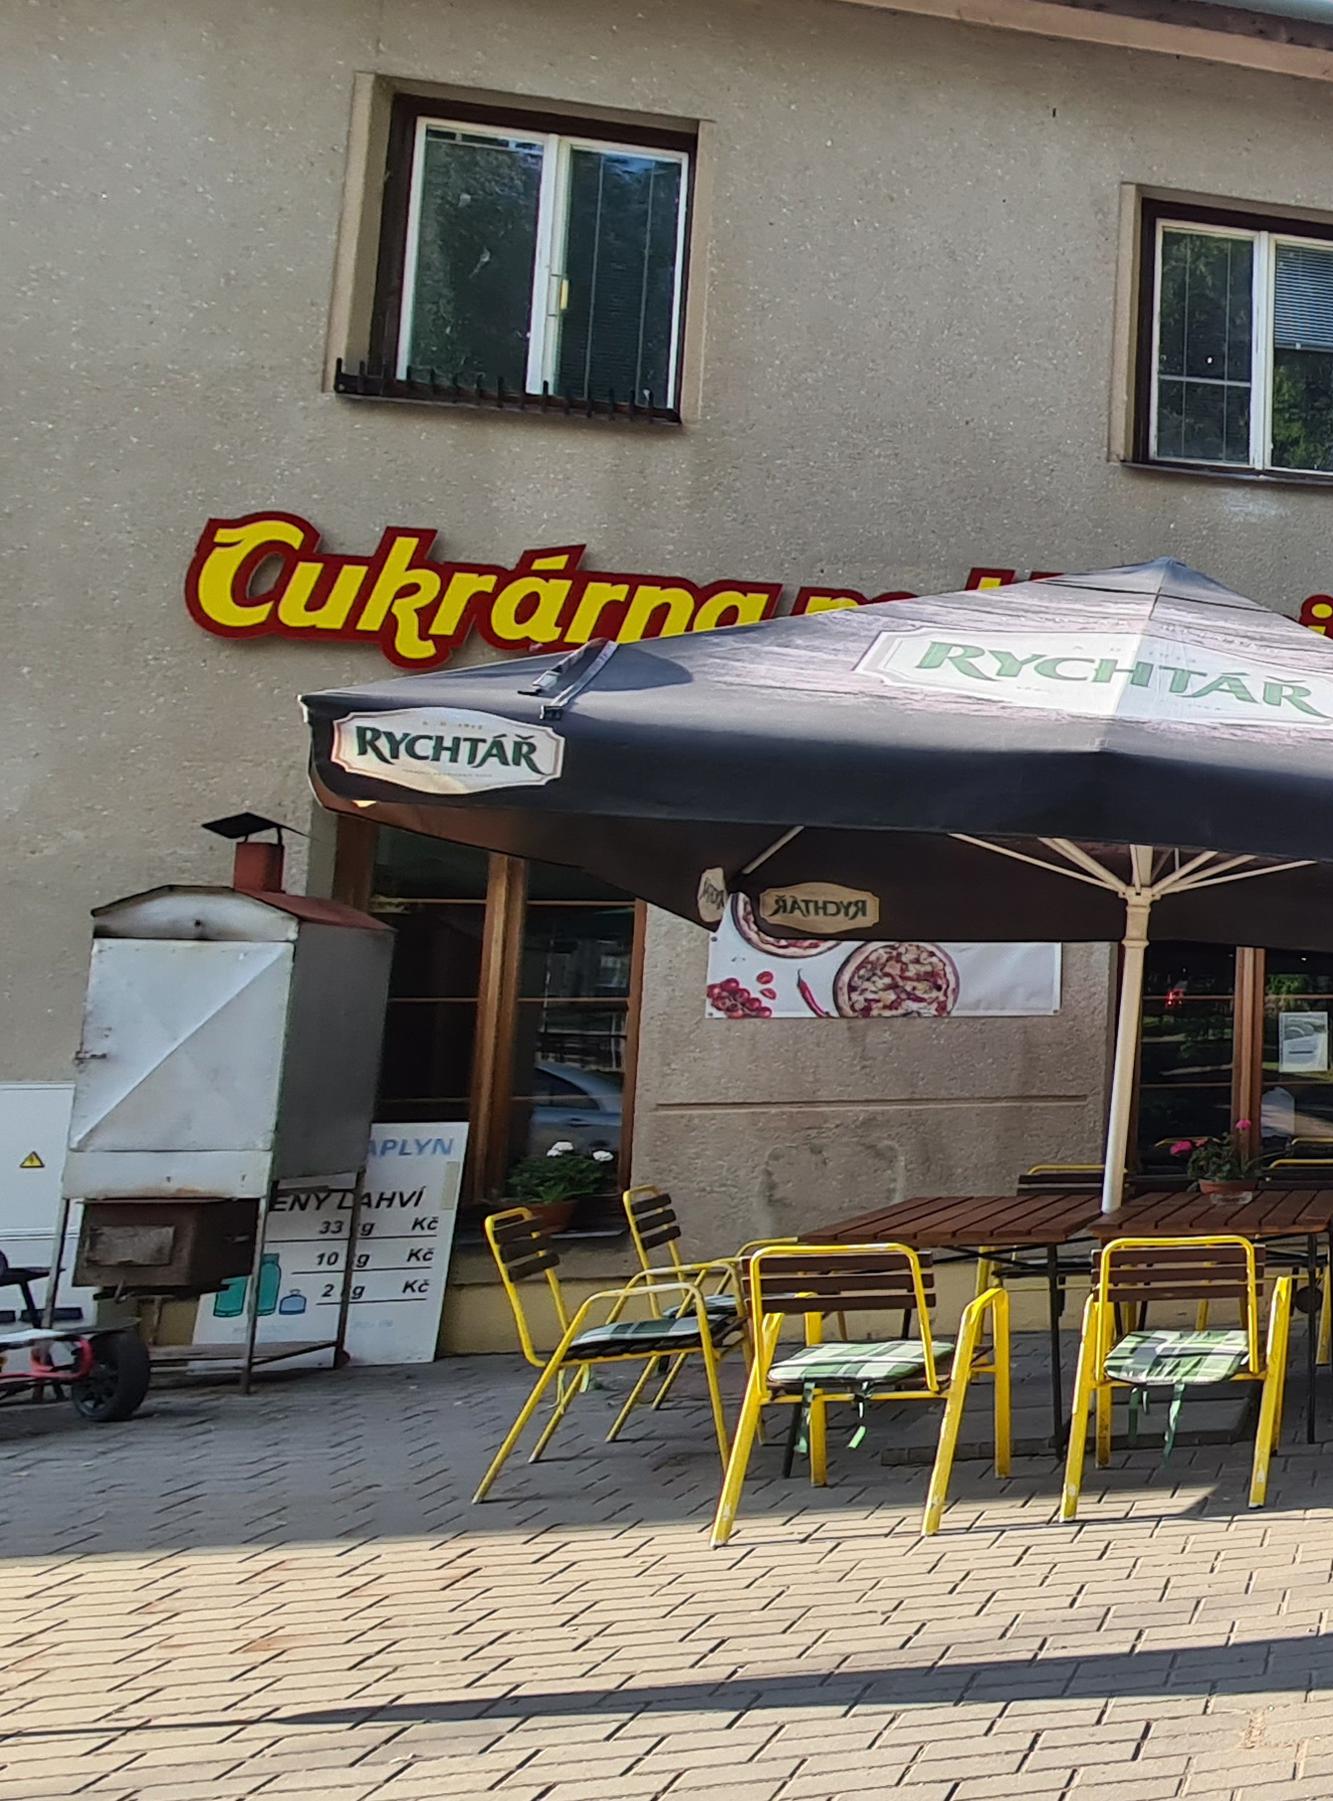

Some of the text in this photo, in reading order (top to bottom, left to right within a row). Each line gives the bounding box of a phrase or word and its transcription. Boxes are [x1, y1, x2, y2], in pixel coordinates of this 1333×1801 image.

[198, 519, 769, 658] Cukrárna
[355, 725, 549, 776] RYCHTÁŘ
[368, 1137, 454, 1158] APLYN
[270, 1190, 331, 1212] ENY
[319, 1219, 344, 1235] 33
[411, 1216, 439, 1232] Kč
[316, 1251, 339, 1267] 10
[407, 1247, 435, 1263] Kč
[322, 1283, 335, 1298] 2
[402, 1279, 431, 1294] Kč
